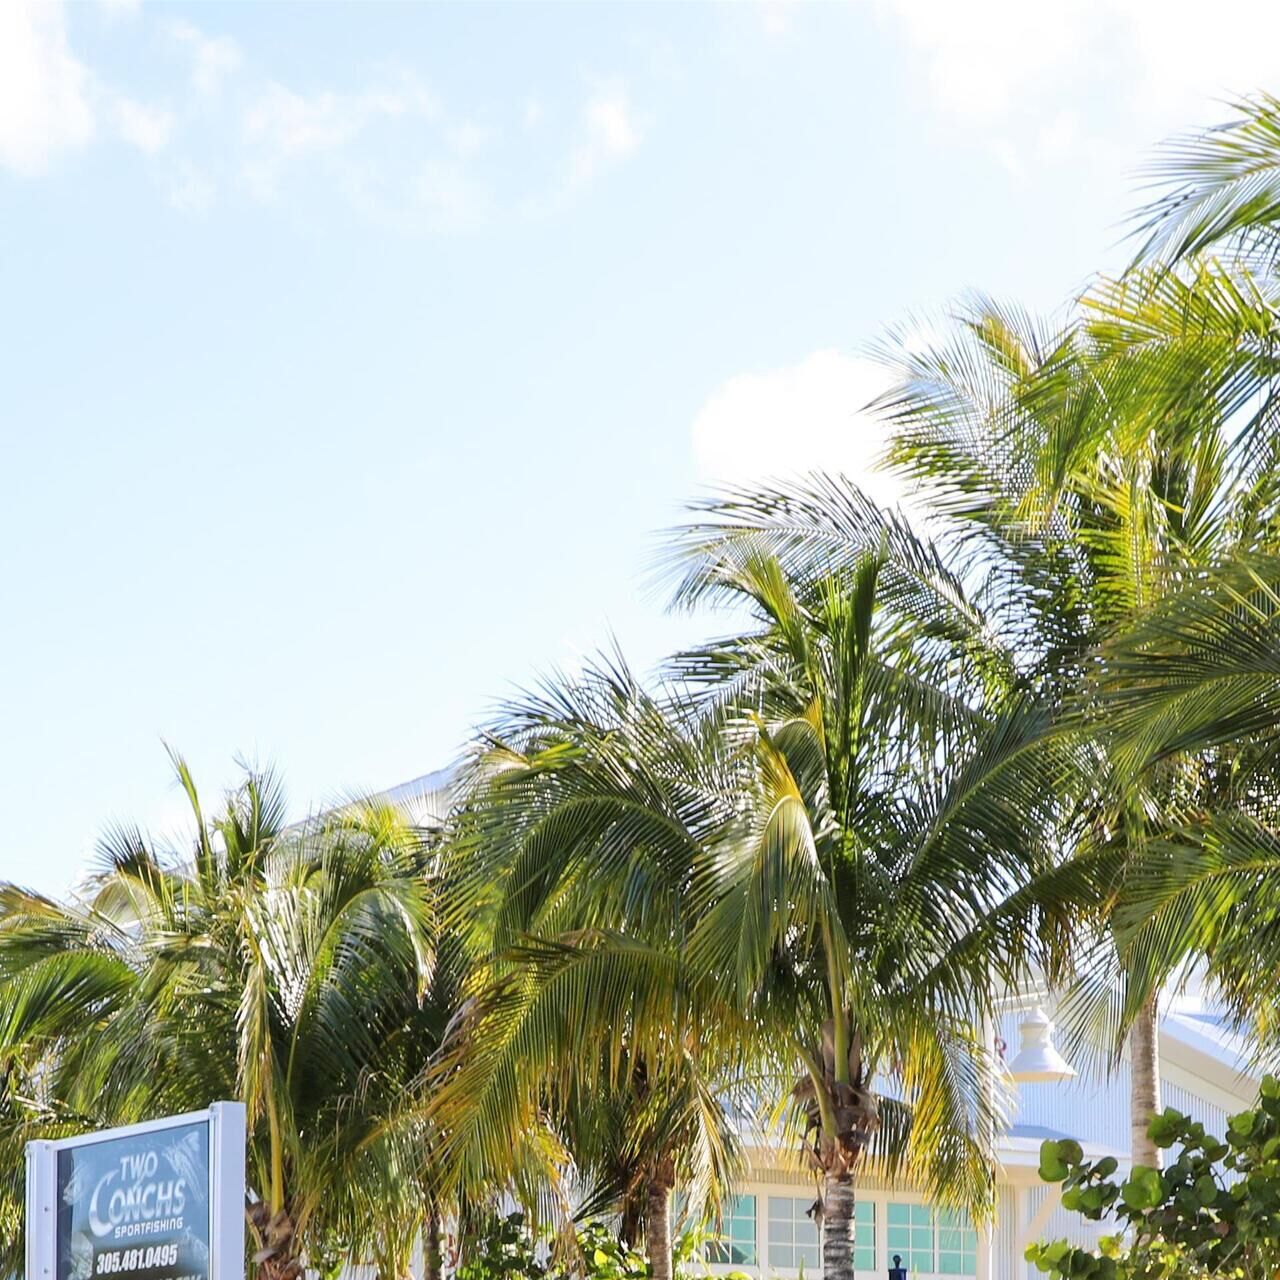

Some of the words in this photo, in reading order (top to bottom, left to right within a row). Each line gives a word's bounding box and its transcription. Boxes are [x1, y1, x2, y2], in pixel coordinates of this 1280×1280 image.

[119, 1151, 158, 1181] TWO
[88, 1168, 186, 1237] CONCHS
[114, 1216, 183, 1239] SPORTFISHING
[96, 1244, 178, 1275] 305.481.0495
